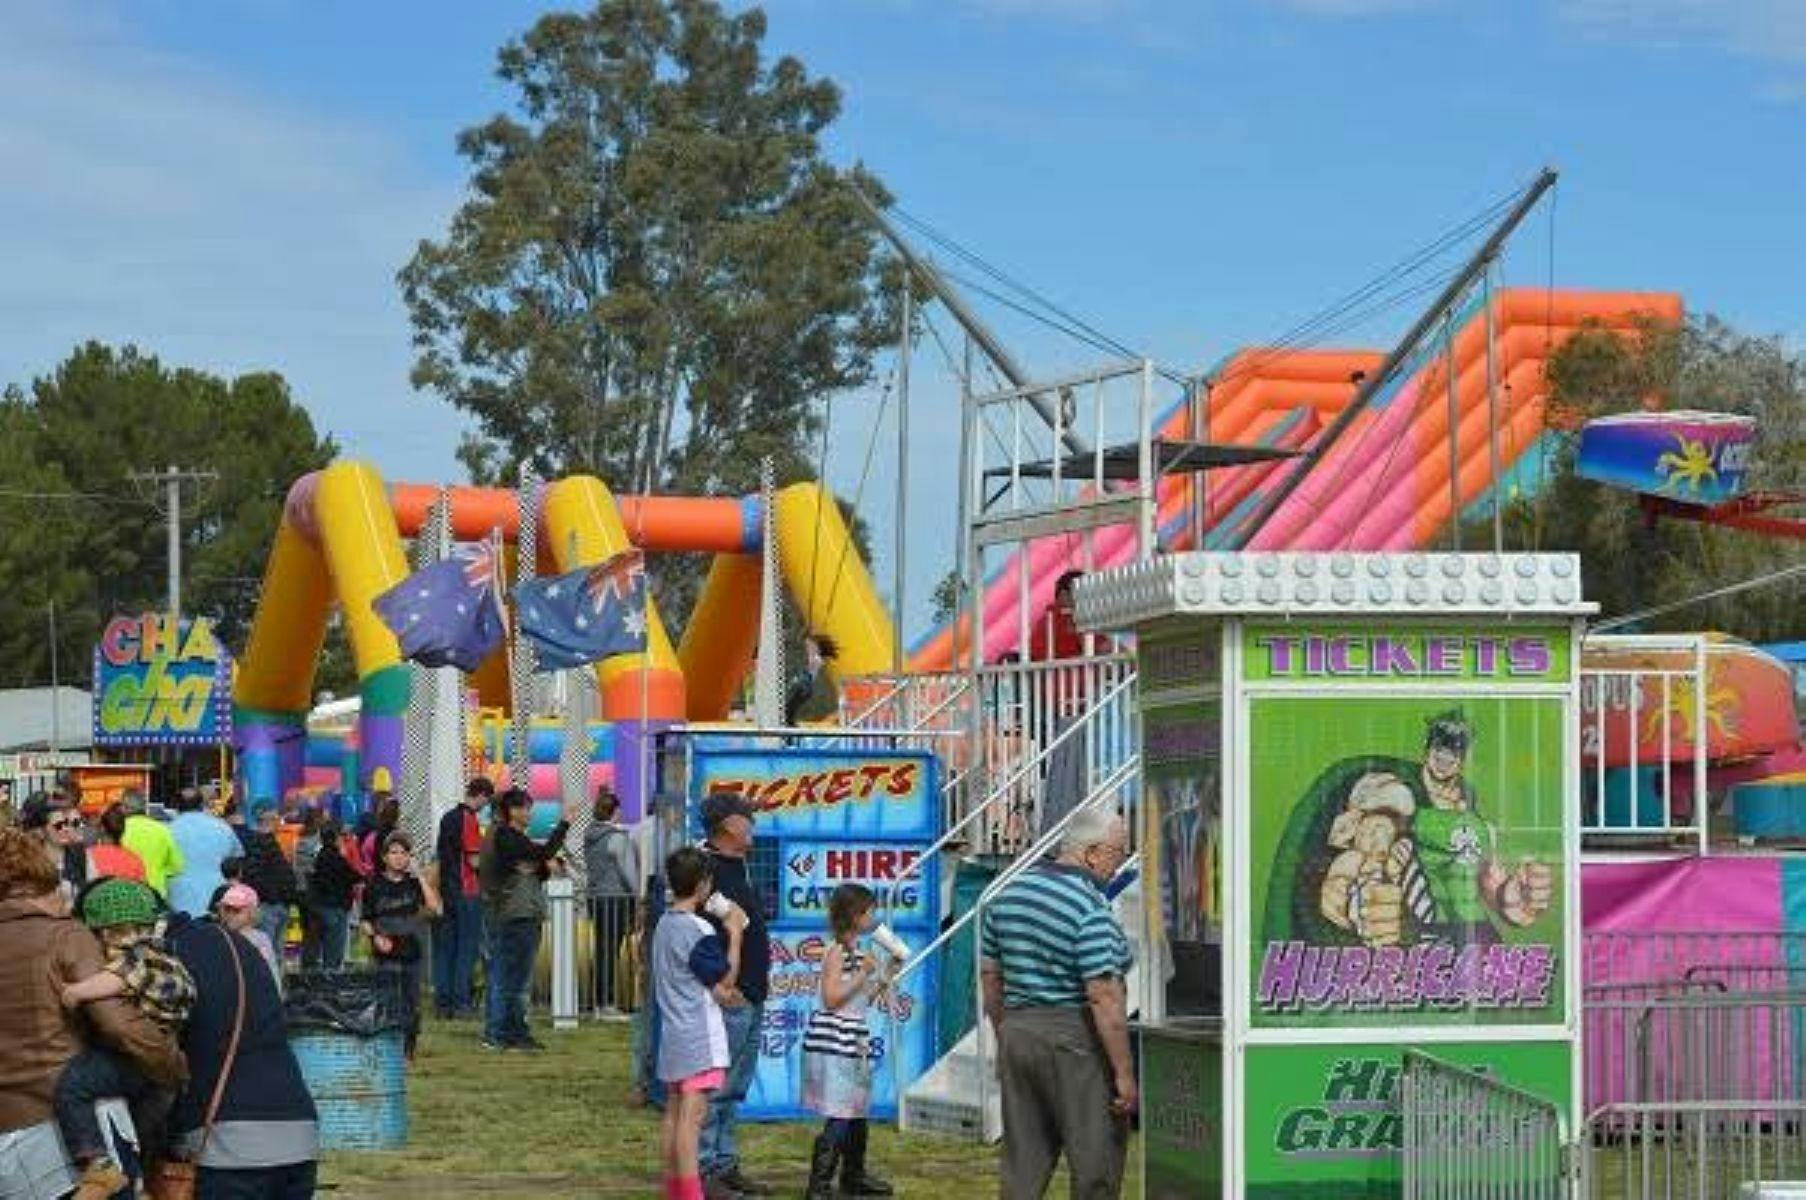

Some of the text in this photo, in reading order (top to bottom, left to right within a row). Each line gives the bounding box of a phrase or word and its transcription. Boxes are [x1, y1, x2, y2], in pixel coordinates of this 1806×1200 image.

[101, 610, 218, 667] CHA
[1257, 633, 1552, 678] TICKETS
[826, 850, 920, 879] HIRE
[788, 886, 918, 909] CATING
[1258, 940, 1557, 1012] HURRICANE
